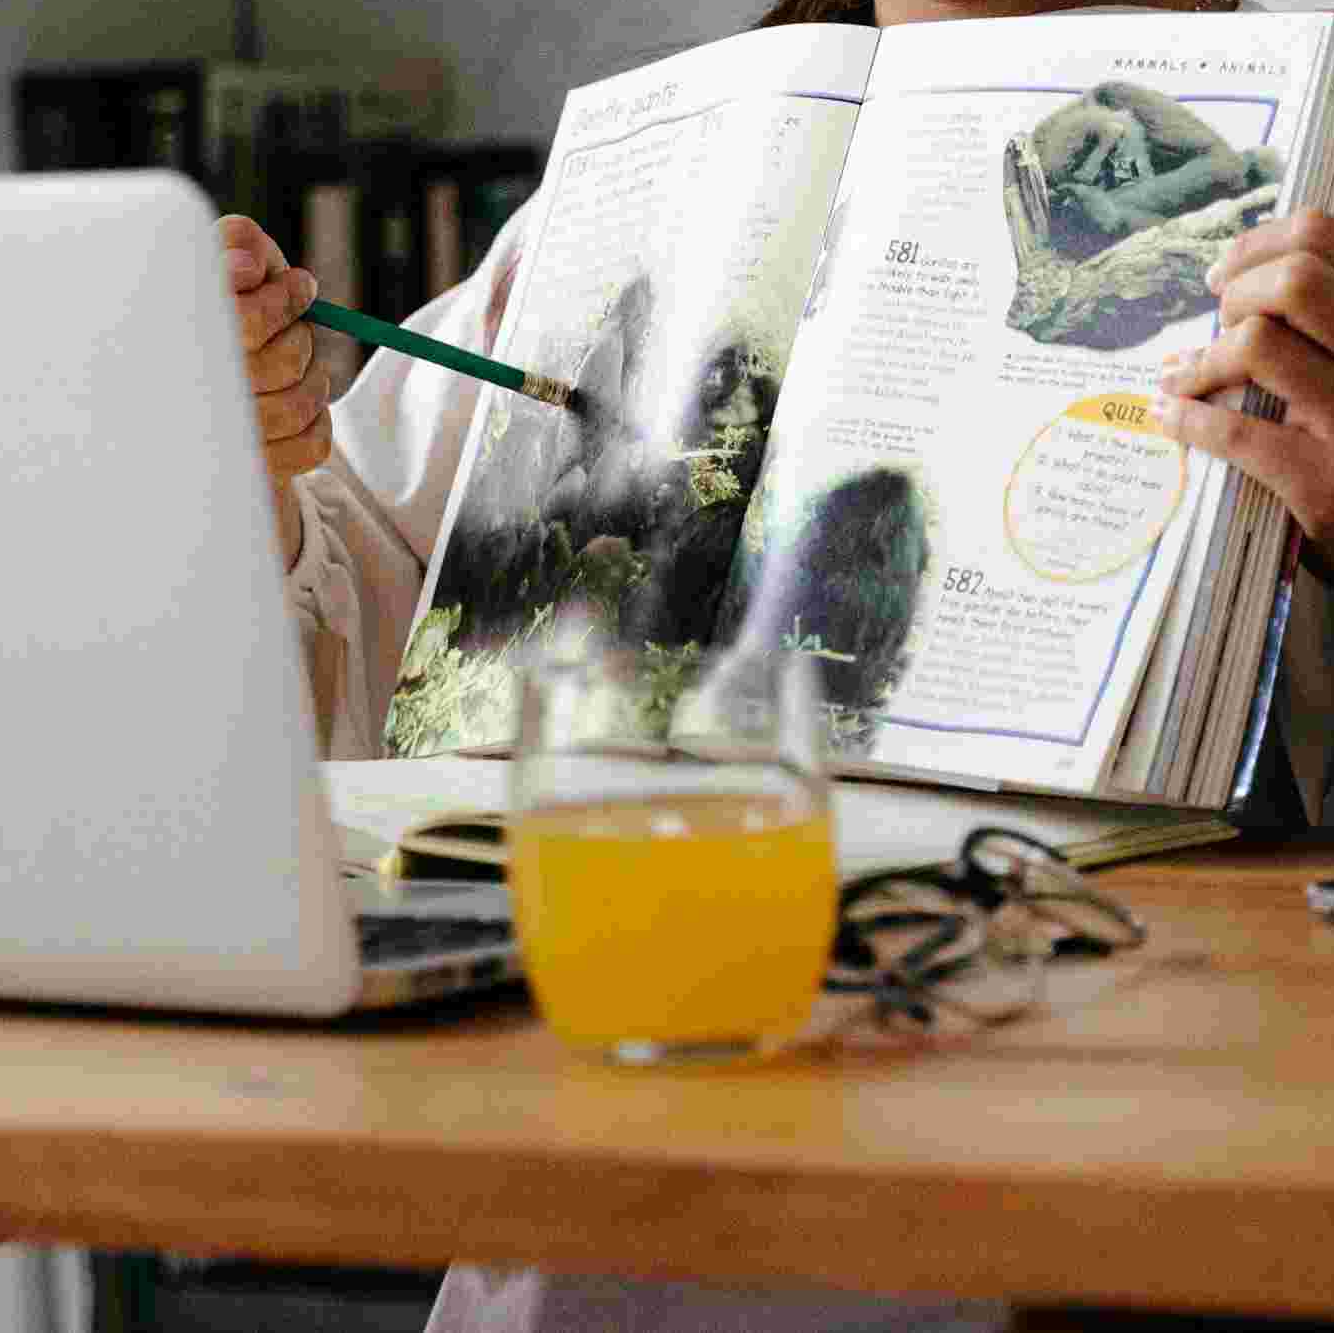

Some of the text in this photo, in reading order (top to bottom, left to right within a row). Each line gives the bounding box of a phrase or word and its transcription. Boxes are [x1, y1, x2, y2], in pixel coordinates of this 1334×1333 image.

[884, 239, 919, 265] 581
[1102, 401, 1147, 425] QUIZ
[942, 566, 985, 595] 582
